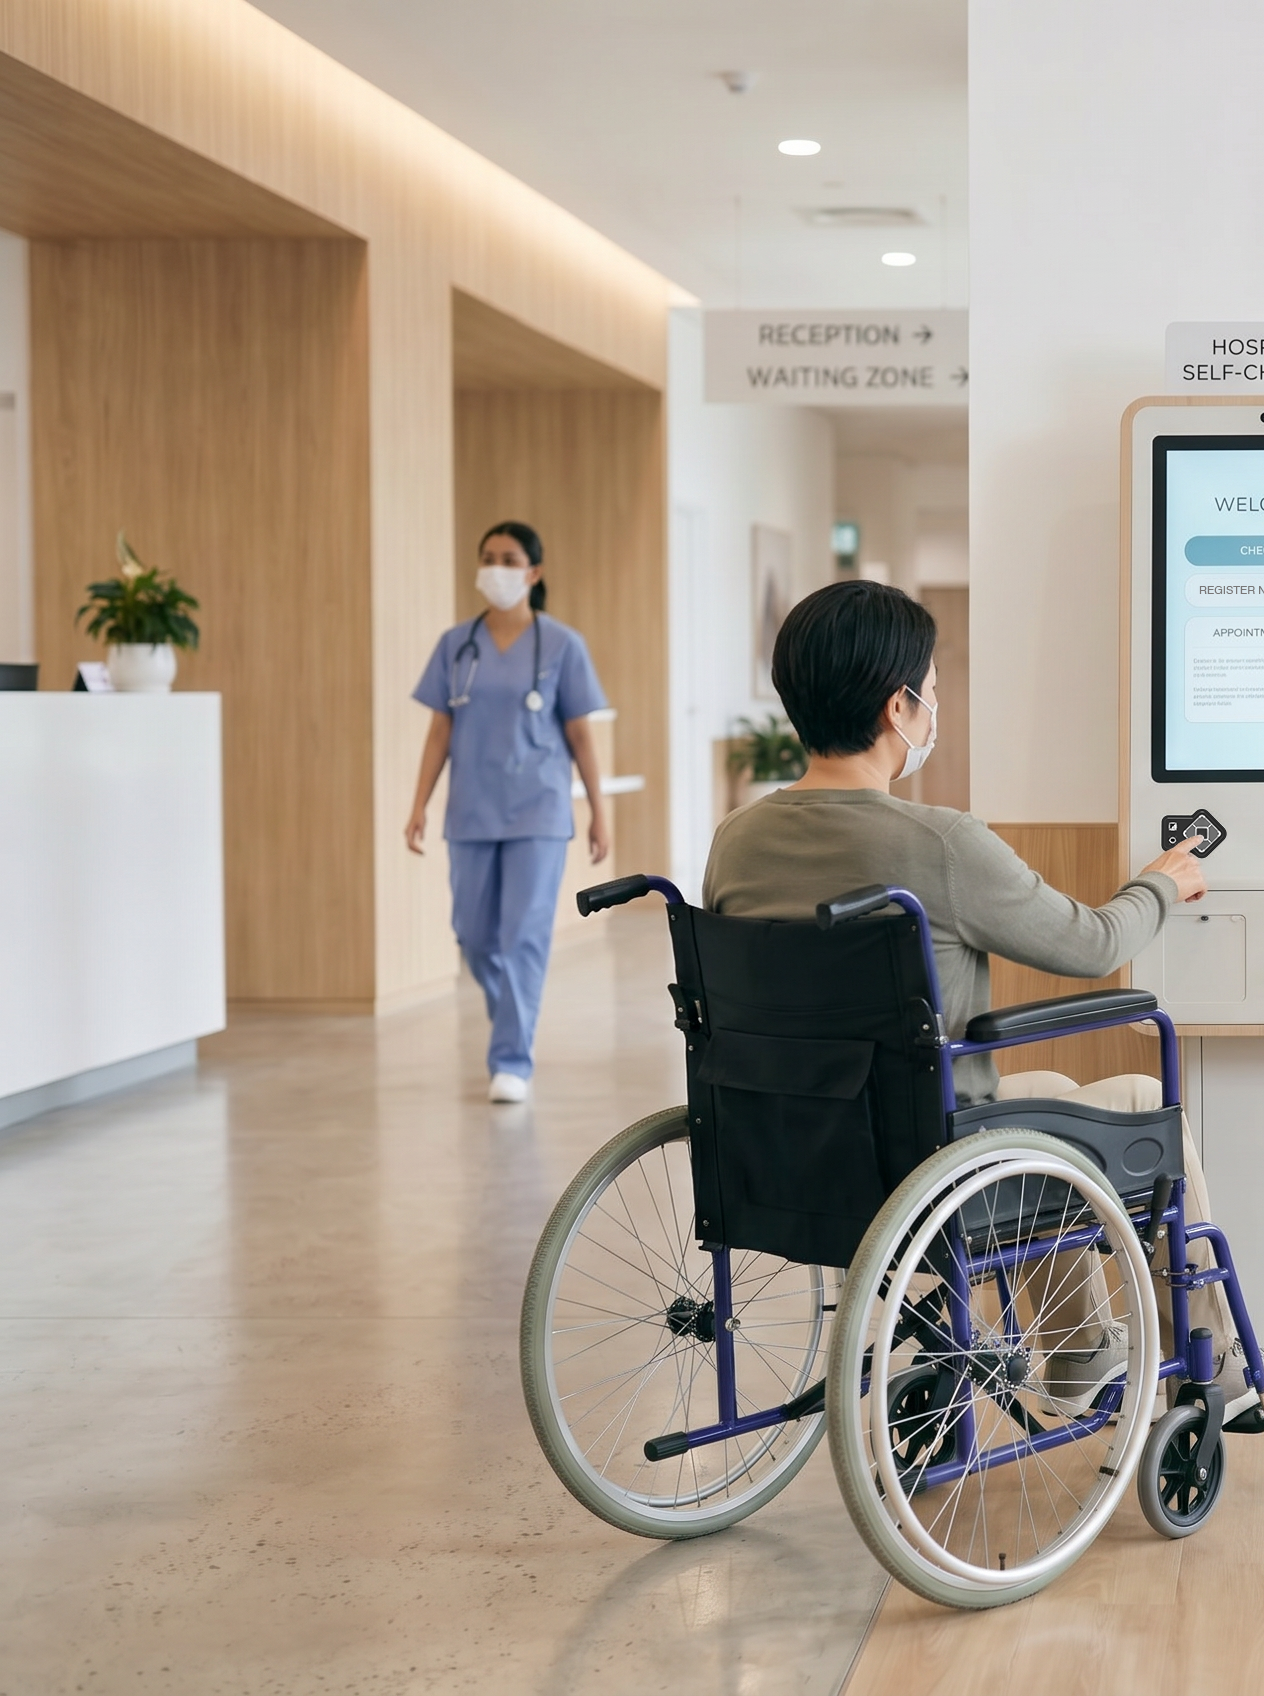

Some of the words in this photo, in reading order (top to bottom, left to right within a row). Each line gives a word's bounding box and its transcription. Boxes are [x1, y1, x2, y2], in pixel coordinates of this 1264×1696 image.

[758, 323, 900, 345] RECEPTION
[747, 366, 858, 388] WAITING
[865, 366, 935, 388] ZONE
[1199, 585, 1255, 595] REGISTER
